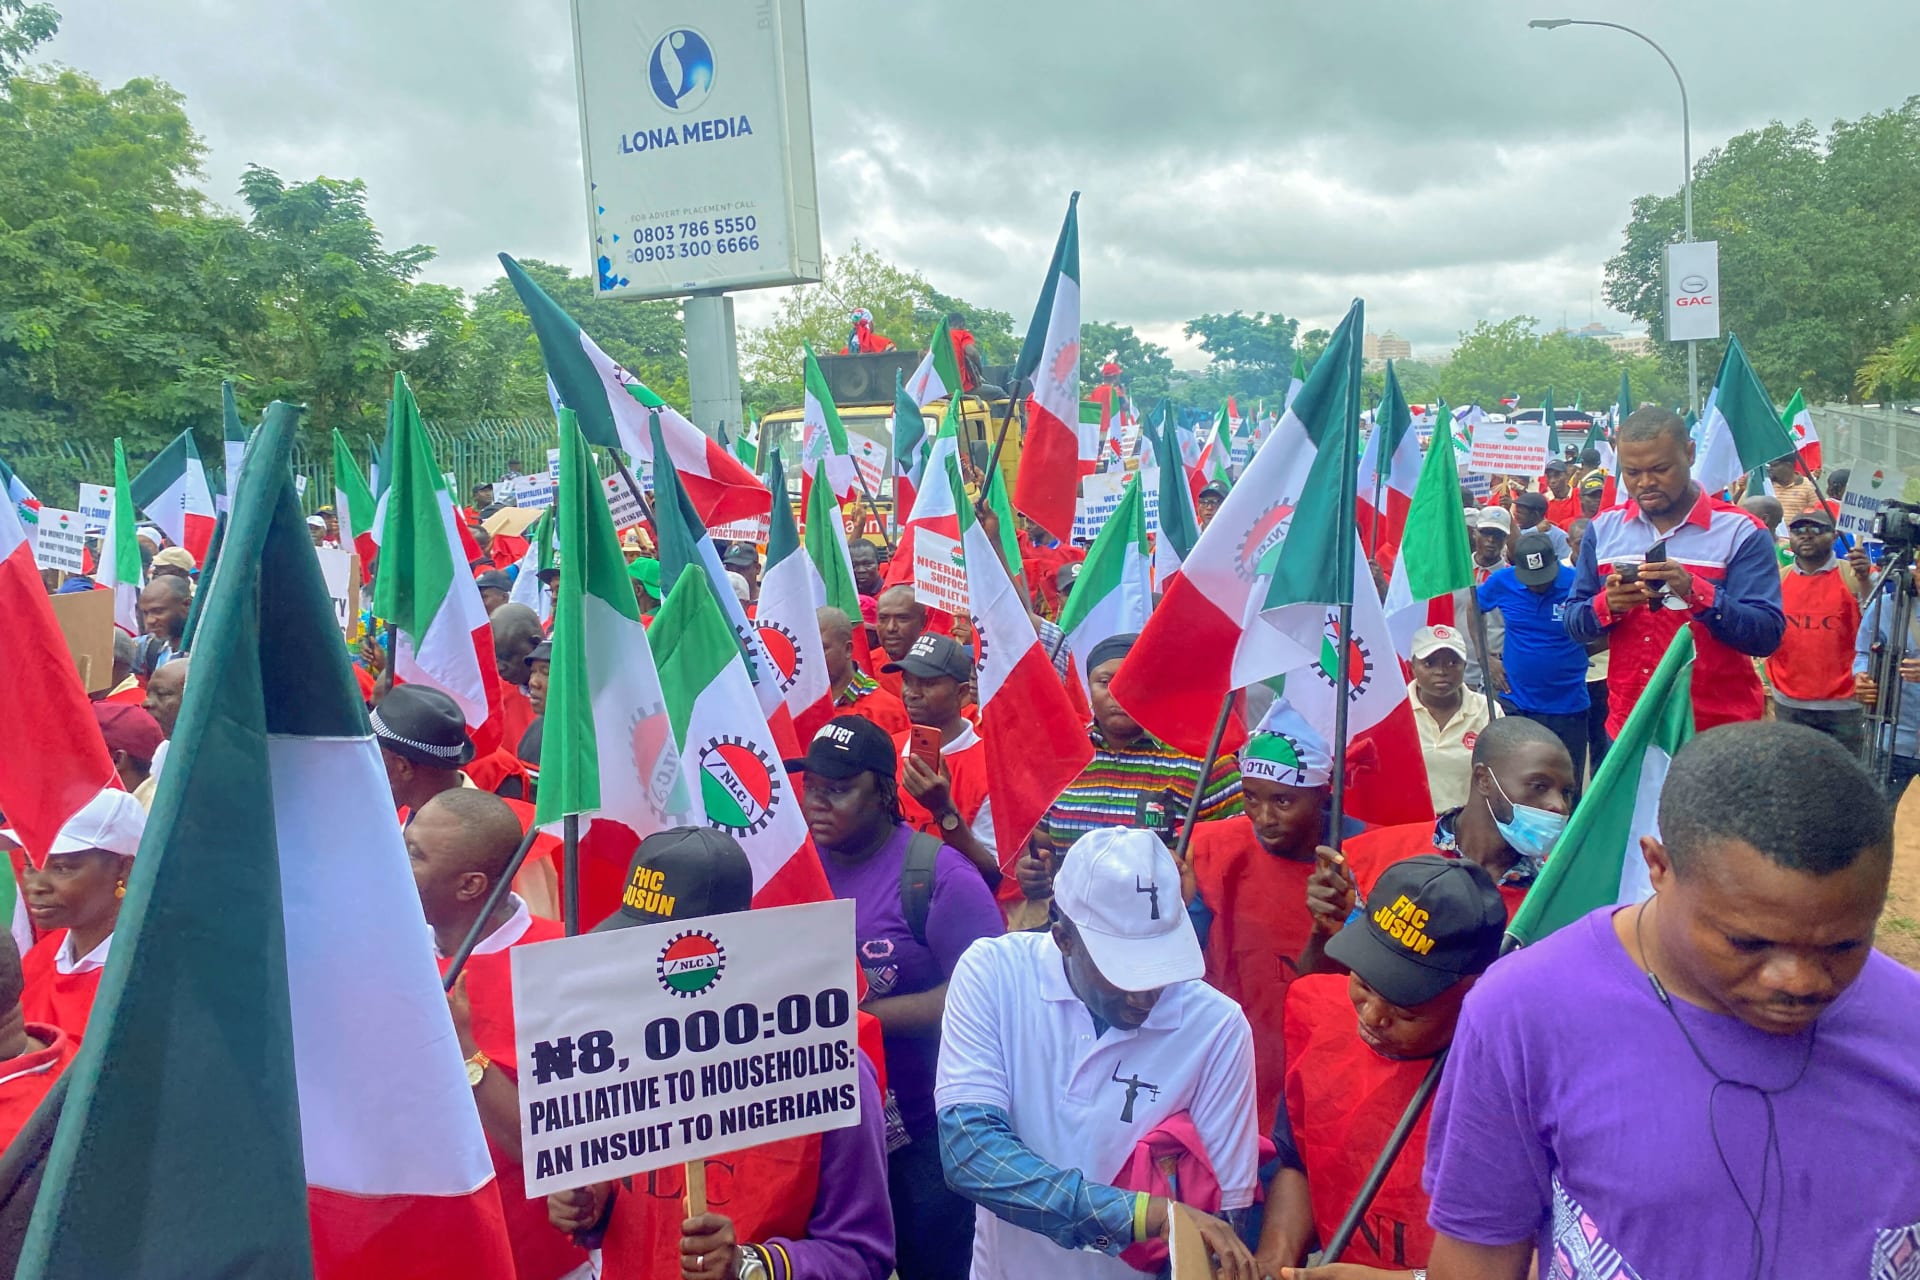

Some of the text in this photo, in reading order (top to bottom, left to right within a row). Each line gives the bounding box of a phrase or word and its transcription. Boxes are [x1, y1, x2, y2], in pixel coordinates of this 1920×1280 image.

[622, 115, 753, 154] LONA MEDIA
[649, 209, 680, 220] ADVERT
[683, 203, 732, 216] PLACEMENT
[735, 200, 757, 210] CALL
[634, 215, 757, 244] 0803 786 5550
[634, 235, 760, 263] 0903 300 6666
[1676, 295, 1713, 307] GAC
[1104, 494, 1116, 503] WE
[1844, 491, 1858, 507] KILL
[1087, 507, 1095, 515] TO
[1839, 513, 1856, 529] NOT
[917, 580, 946, 597] TINUBU
[948, 589, 959, 602] LET
[1785, 614, 1841, 631] NLC
[832, 726, 855, 745] FCT
[1246, 761, 1276, 777] NLC
[720, 770, 747, 803] NLC
[1145, 813, 1165, 826] NUT
[633, 865, 665, 892] FHC
[623, 884, 675, 917] JUSUN
[1391, 894, 1430, 930] FHC
[1374, 906, 1436, 956] JUSUN
[680, 958, 704, 971] NLC
[644, 988, 849, 1060] 000:00
[530, 1040, 855, 1135] PALLIATIVE TO HOUSEHOLDS:
[536, 1083, 856, 1180] AN INSULT TO NIGERIANS
